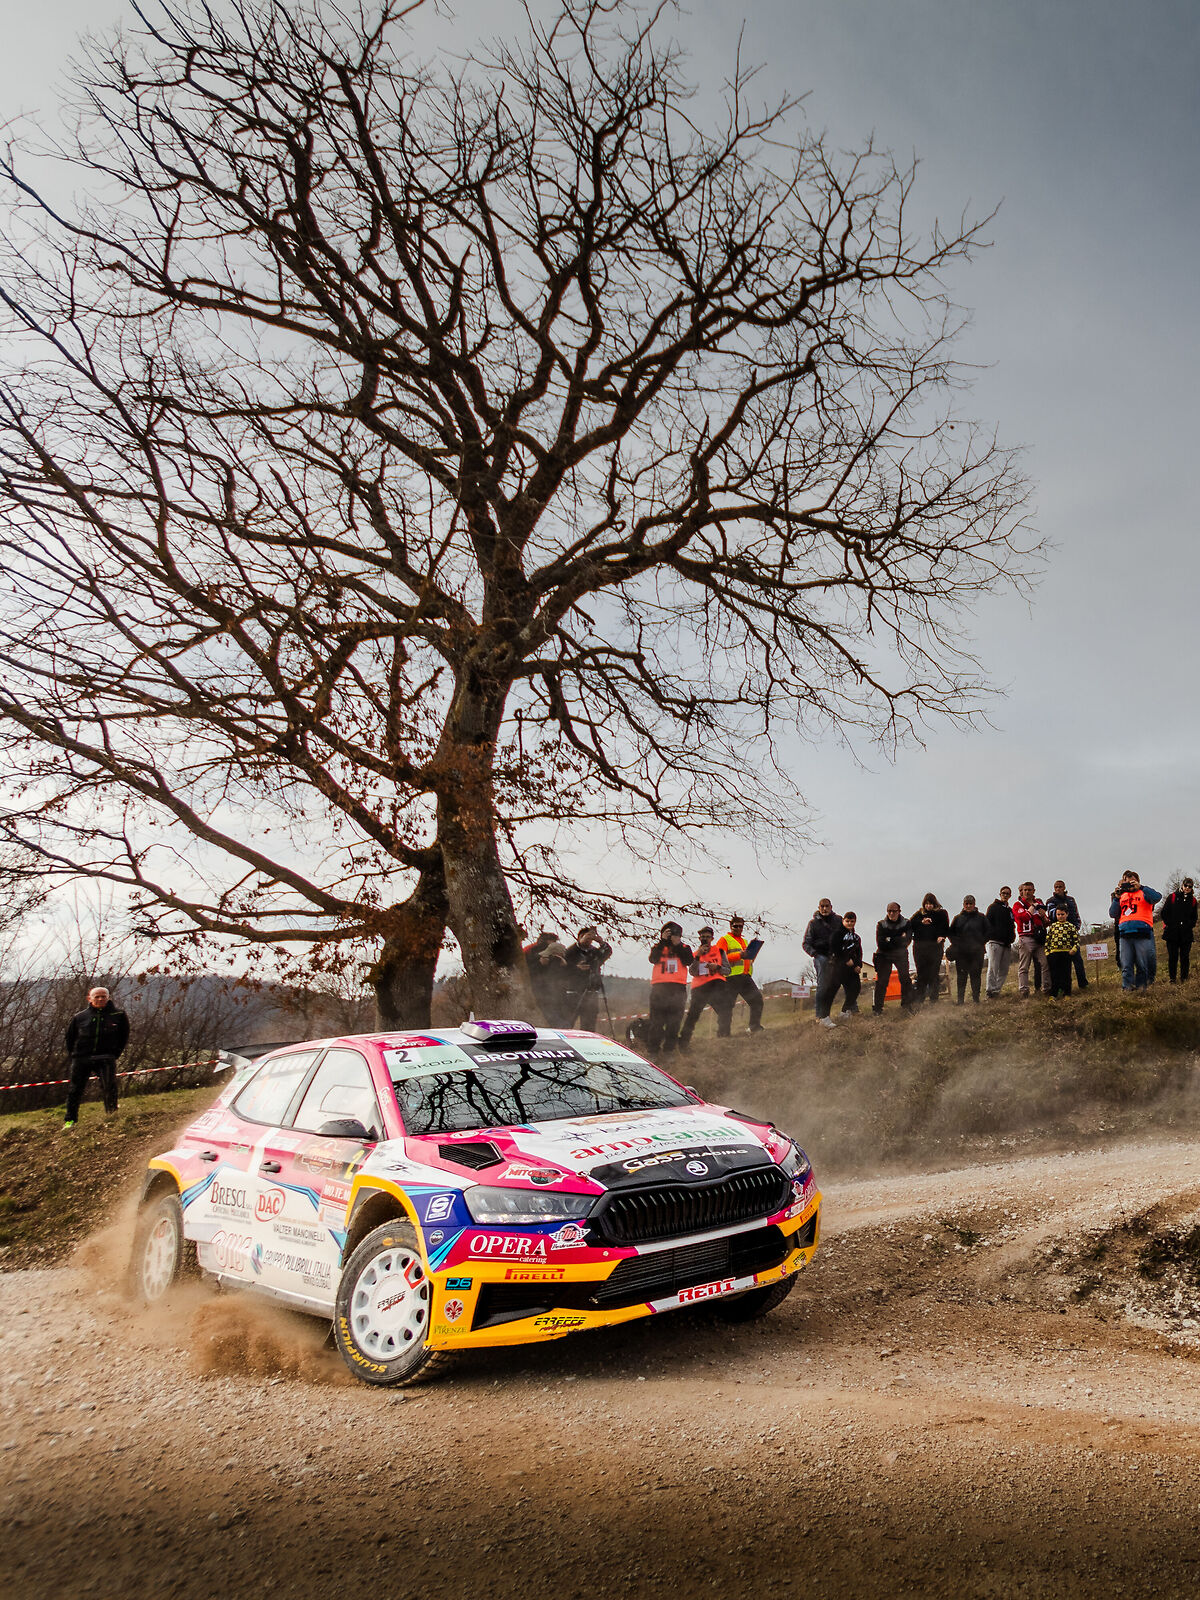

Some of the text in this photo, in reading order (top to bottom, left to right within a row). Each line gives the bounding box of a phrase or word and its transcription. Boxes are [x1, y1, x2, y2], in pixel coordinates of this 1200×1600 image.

[395, 1050, 412, 1063] 2
[475, 1050, 575, 1063] BROTINI.IT
[258, 1194, 280, 1215] DAC
[470, 1235, 548, 1256] OPERA
[519, 1255, 548, 1265] catering
[505, 1268, 566, 1280] PIRELLI
[446, 1277, 472, 1287] D6
[433, 1326, 467, 1335] FIRENZE
